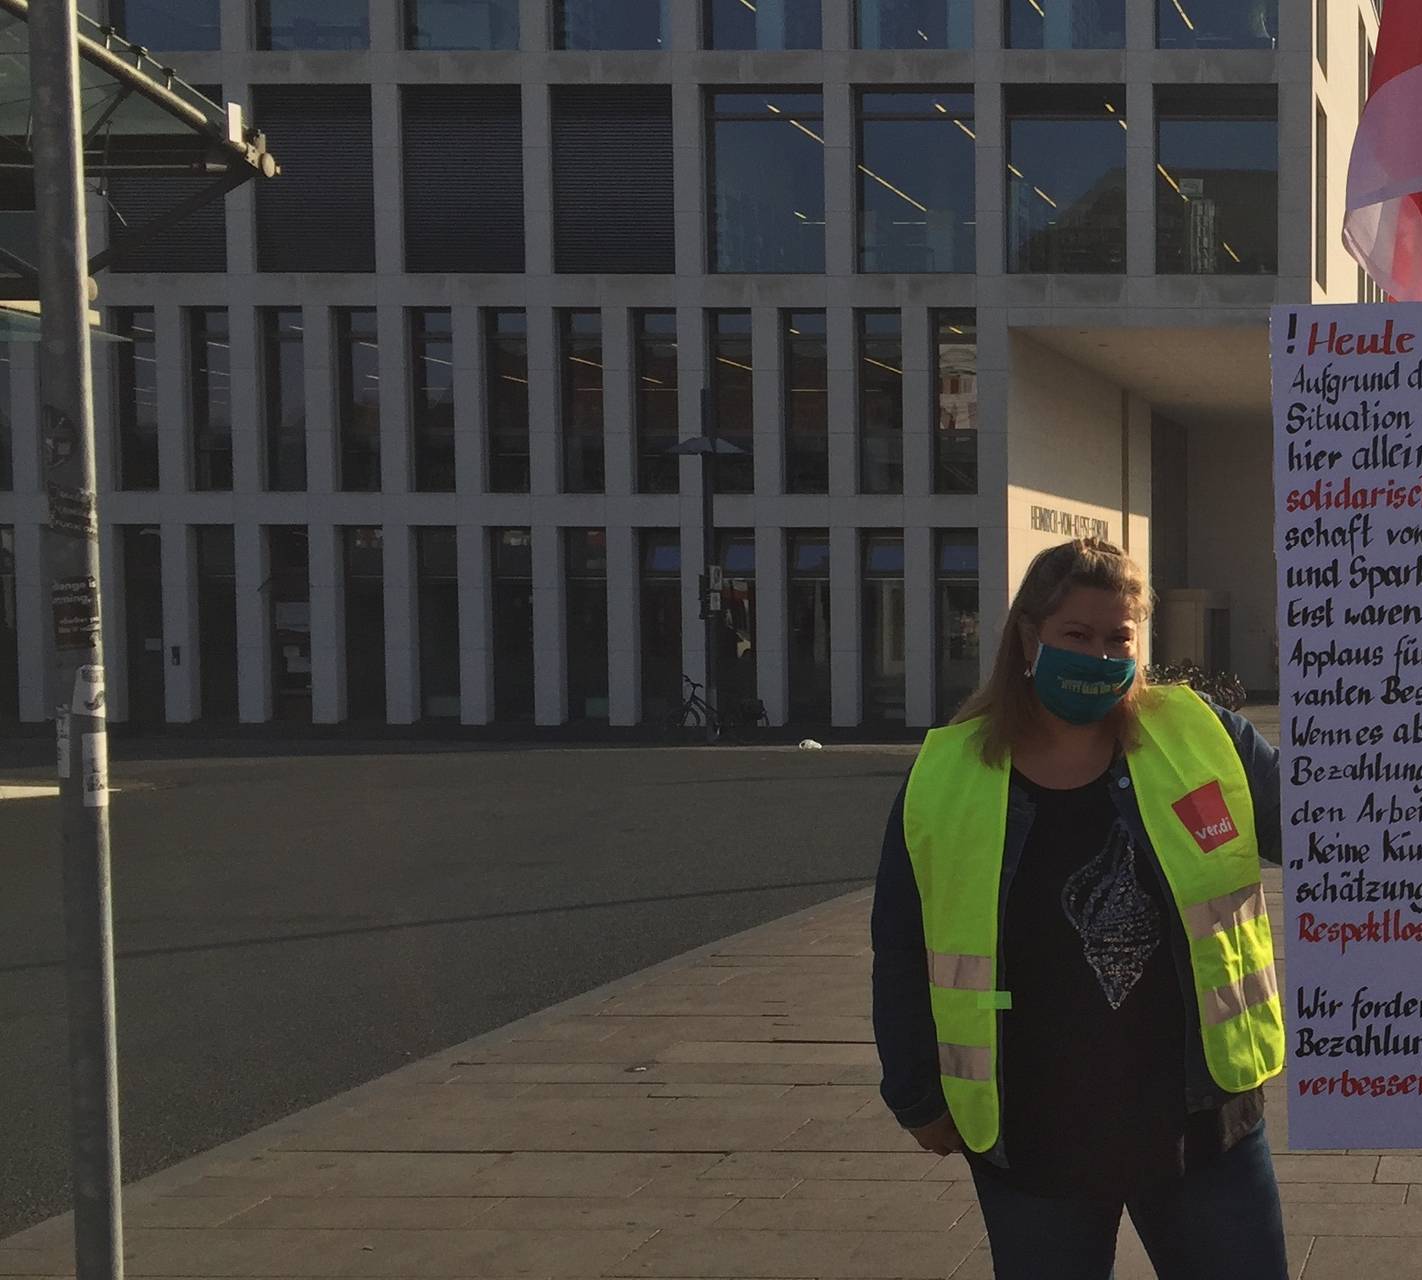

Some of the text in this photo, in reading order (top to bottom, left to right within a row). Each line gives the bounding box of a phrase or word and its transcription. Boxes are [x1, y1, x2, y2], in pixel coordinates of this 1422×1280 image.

[1308, 321, 1415, 356] Heute
[1292, 361, 1399, 401] Aufgrund
[1286, 401, 1410, 434] Situation
[1288, 443, 1341, 471] hier
[1285, 513, 1373, 555] schaft
[1287, 561, 1342, 589] und
[1288, 599, 1334, 628] Erst
[1289, 638, 1383, 678] Applaus
[1292, 677, 1374, 706] vanten
[1196, 816, 1232, 839] ver.di
[1291, 800, 1346, 826] den
[1298, 987, 1342, 1019] Wir
